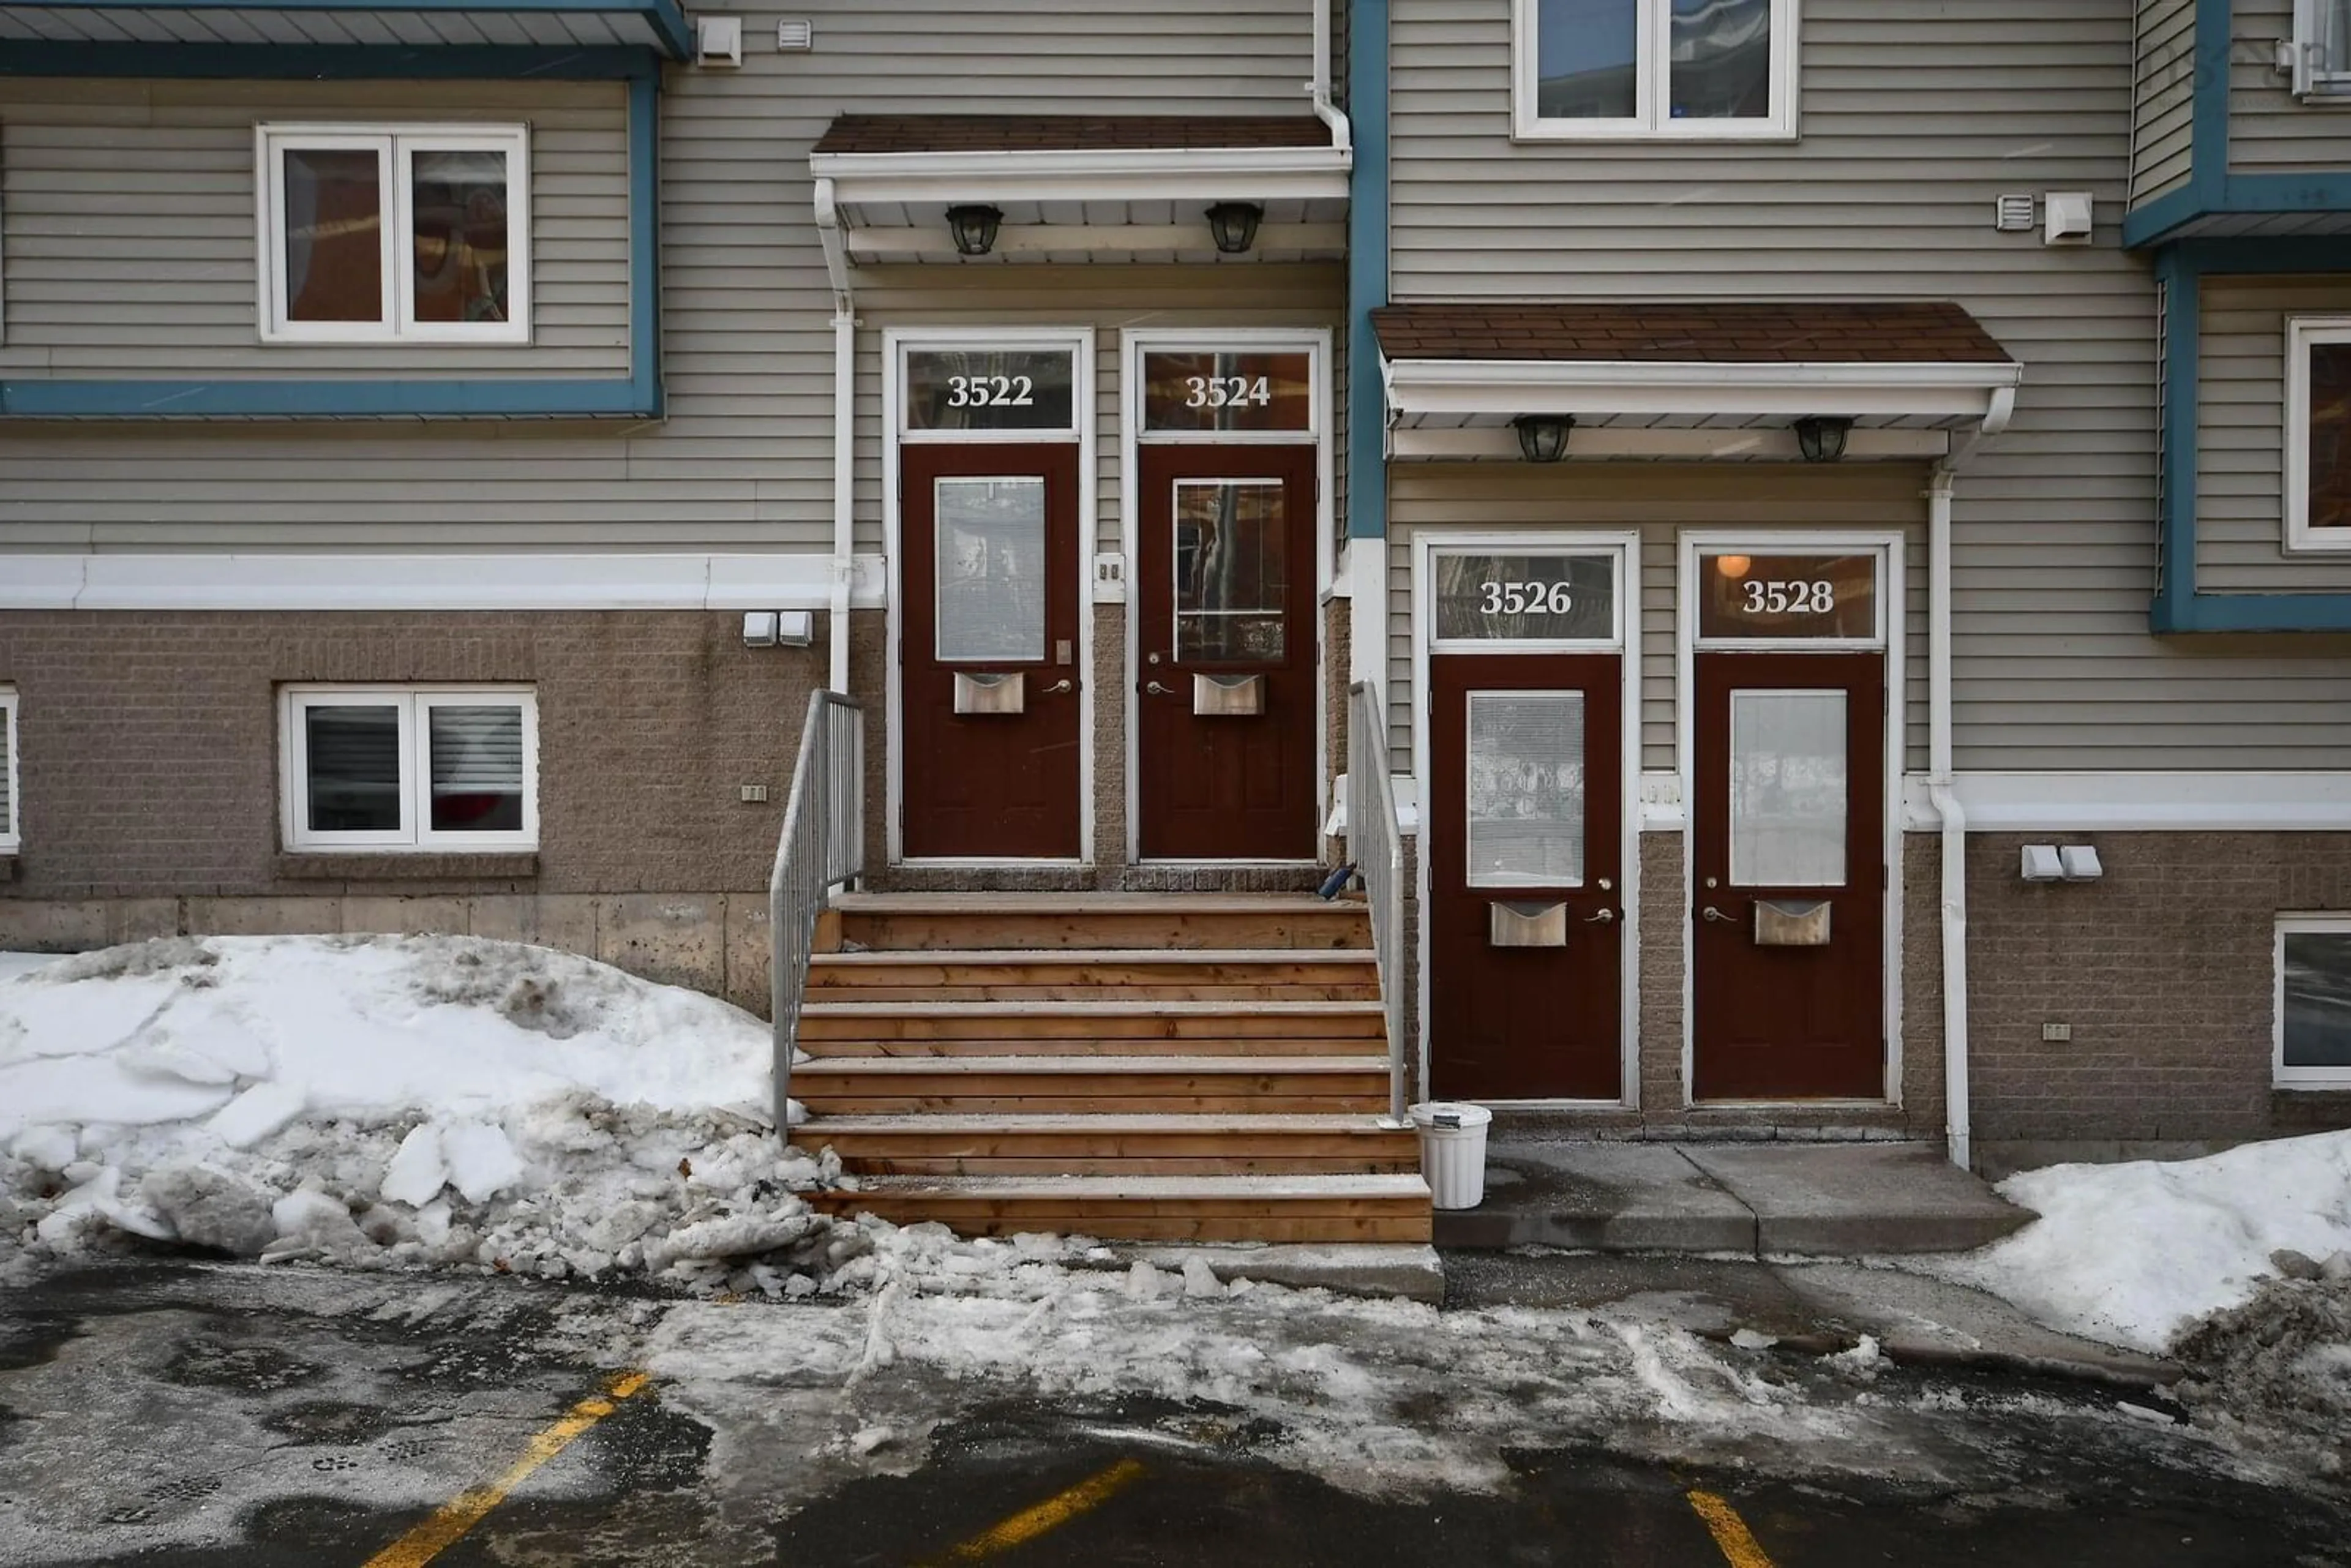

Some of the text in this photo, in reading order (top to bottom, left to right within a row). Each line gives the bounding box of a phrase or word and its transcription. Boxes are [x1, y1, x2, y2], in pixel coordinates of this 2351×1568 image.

[948, 375, 1033, 407] 3522
[1185, 376, 1270, 407] 3524
[1480, 581, 1572, 615] 3526
[1742, 580, 1834, 613] 3528
